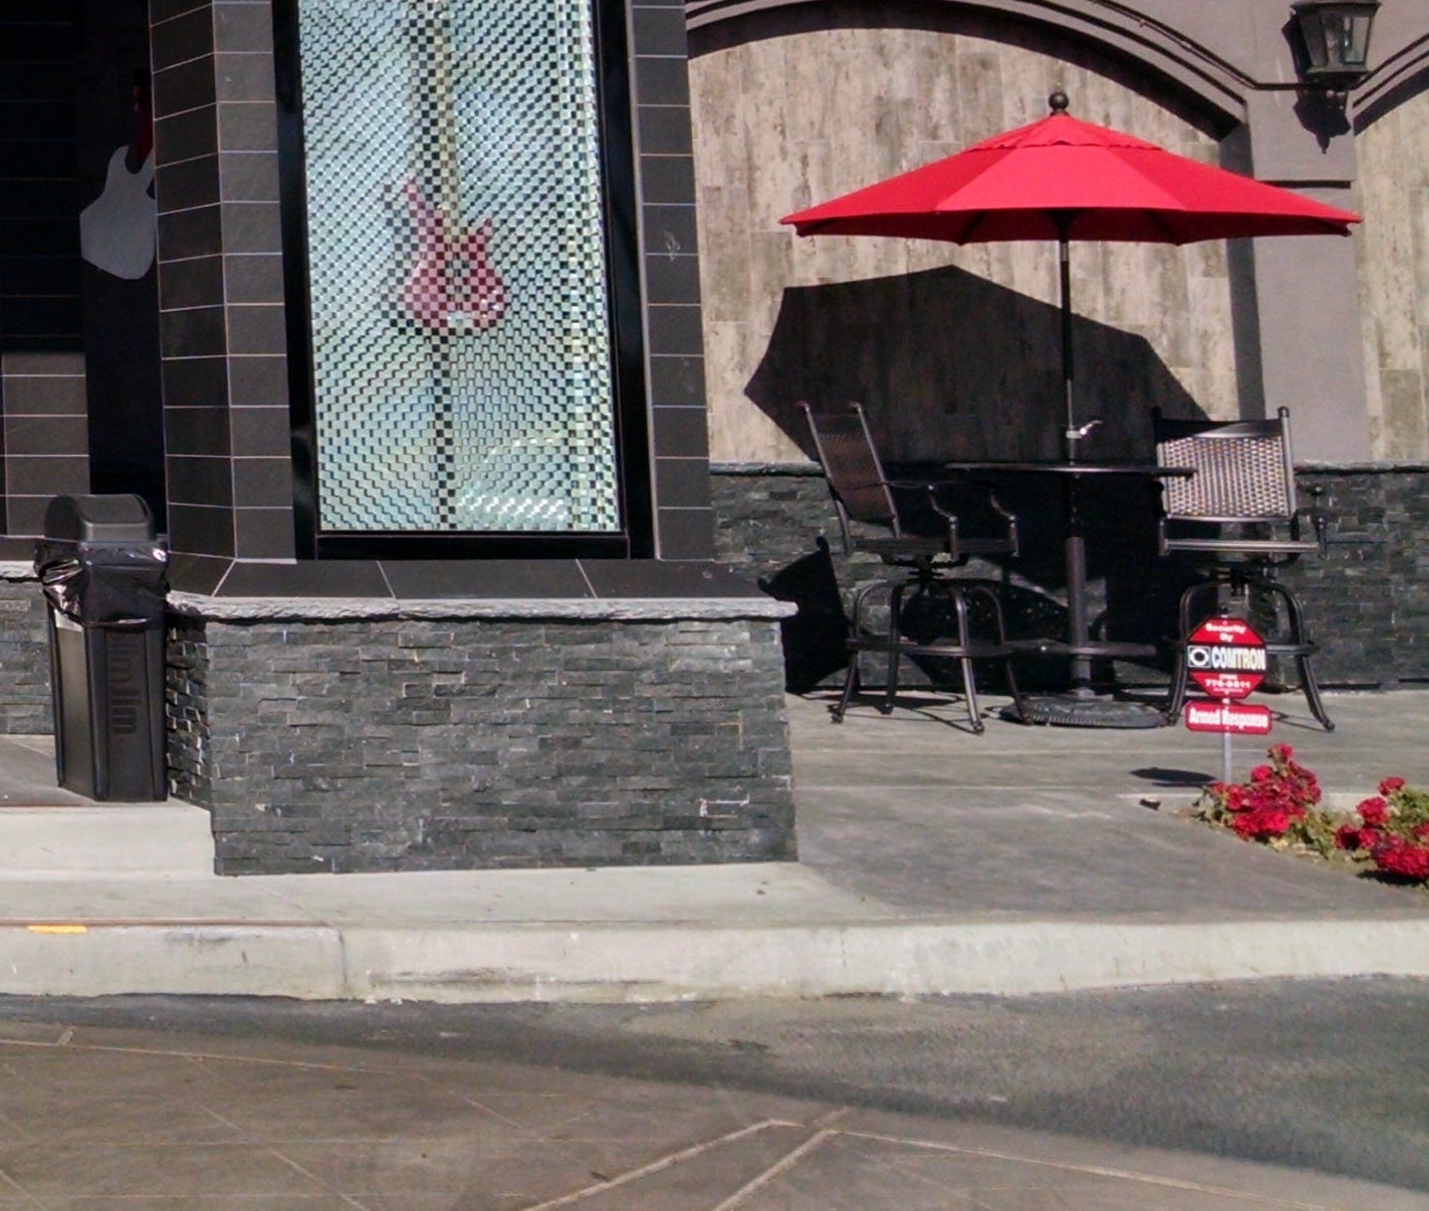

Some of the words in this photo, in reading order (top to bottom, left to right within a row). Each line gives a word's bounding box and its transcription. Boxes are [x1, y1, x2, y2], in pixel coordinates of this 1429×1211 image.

[1212, 646, 1266, 670] COMTRON
[1189, 708, 1220, 725] Armed
[1222, 709, 1268, 730] Response
